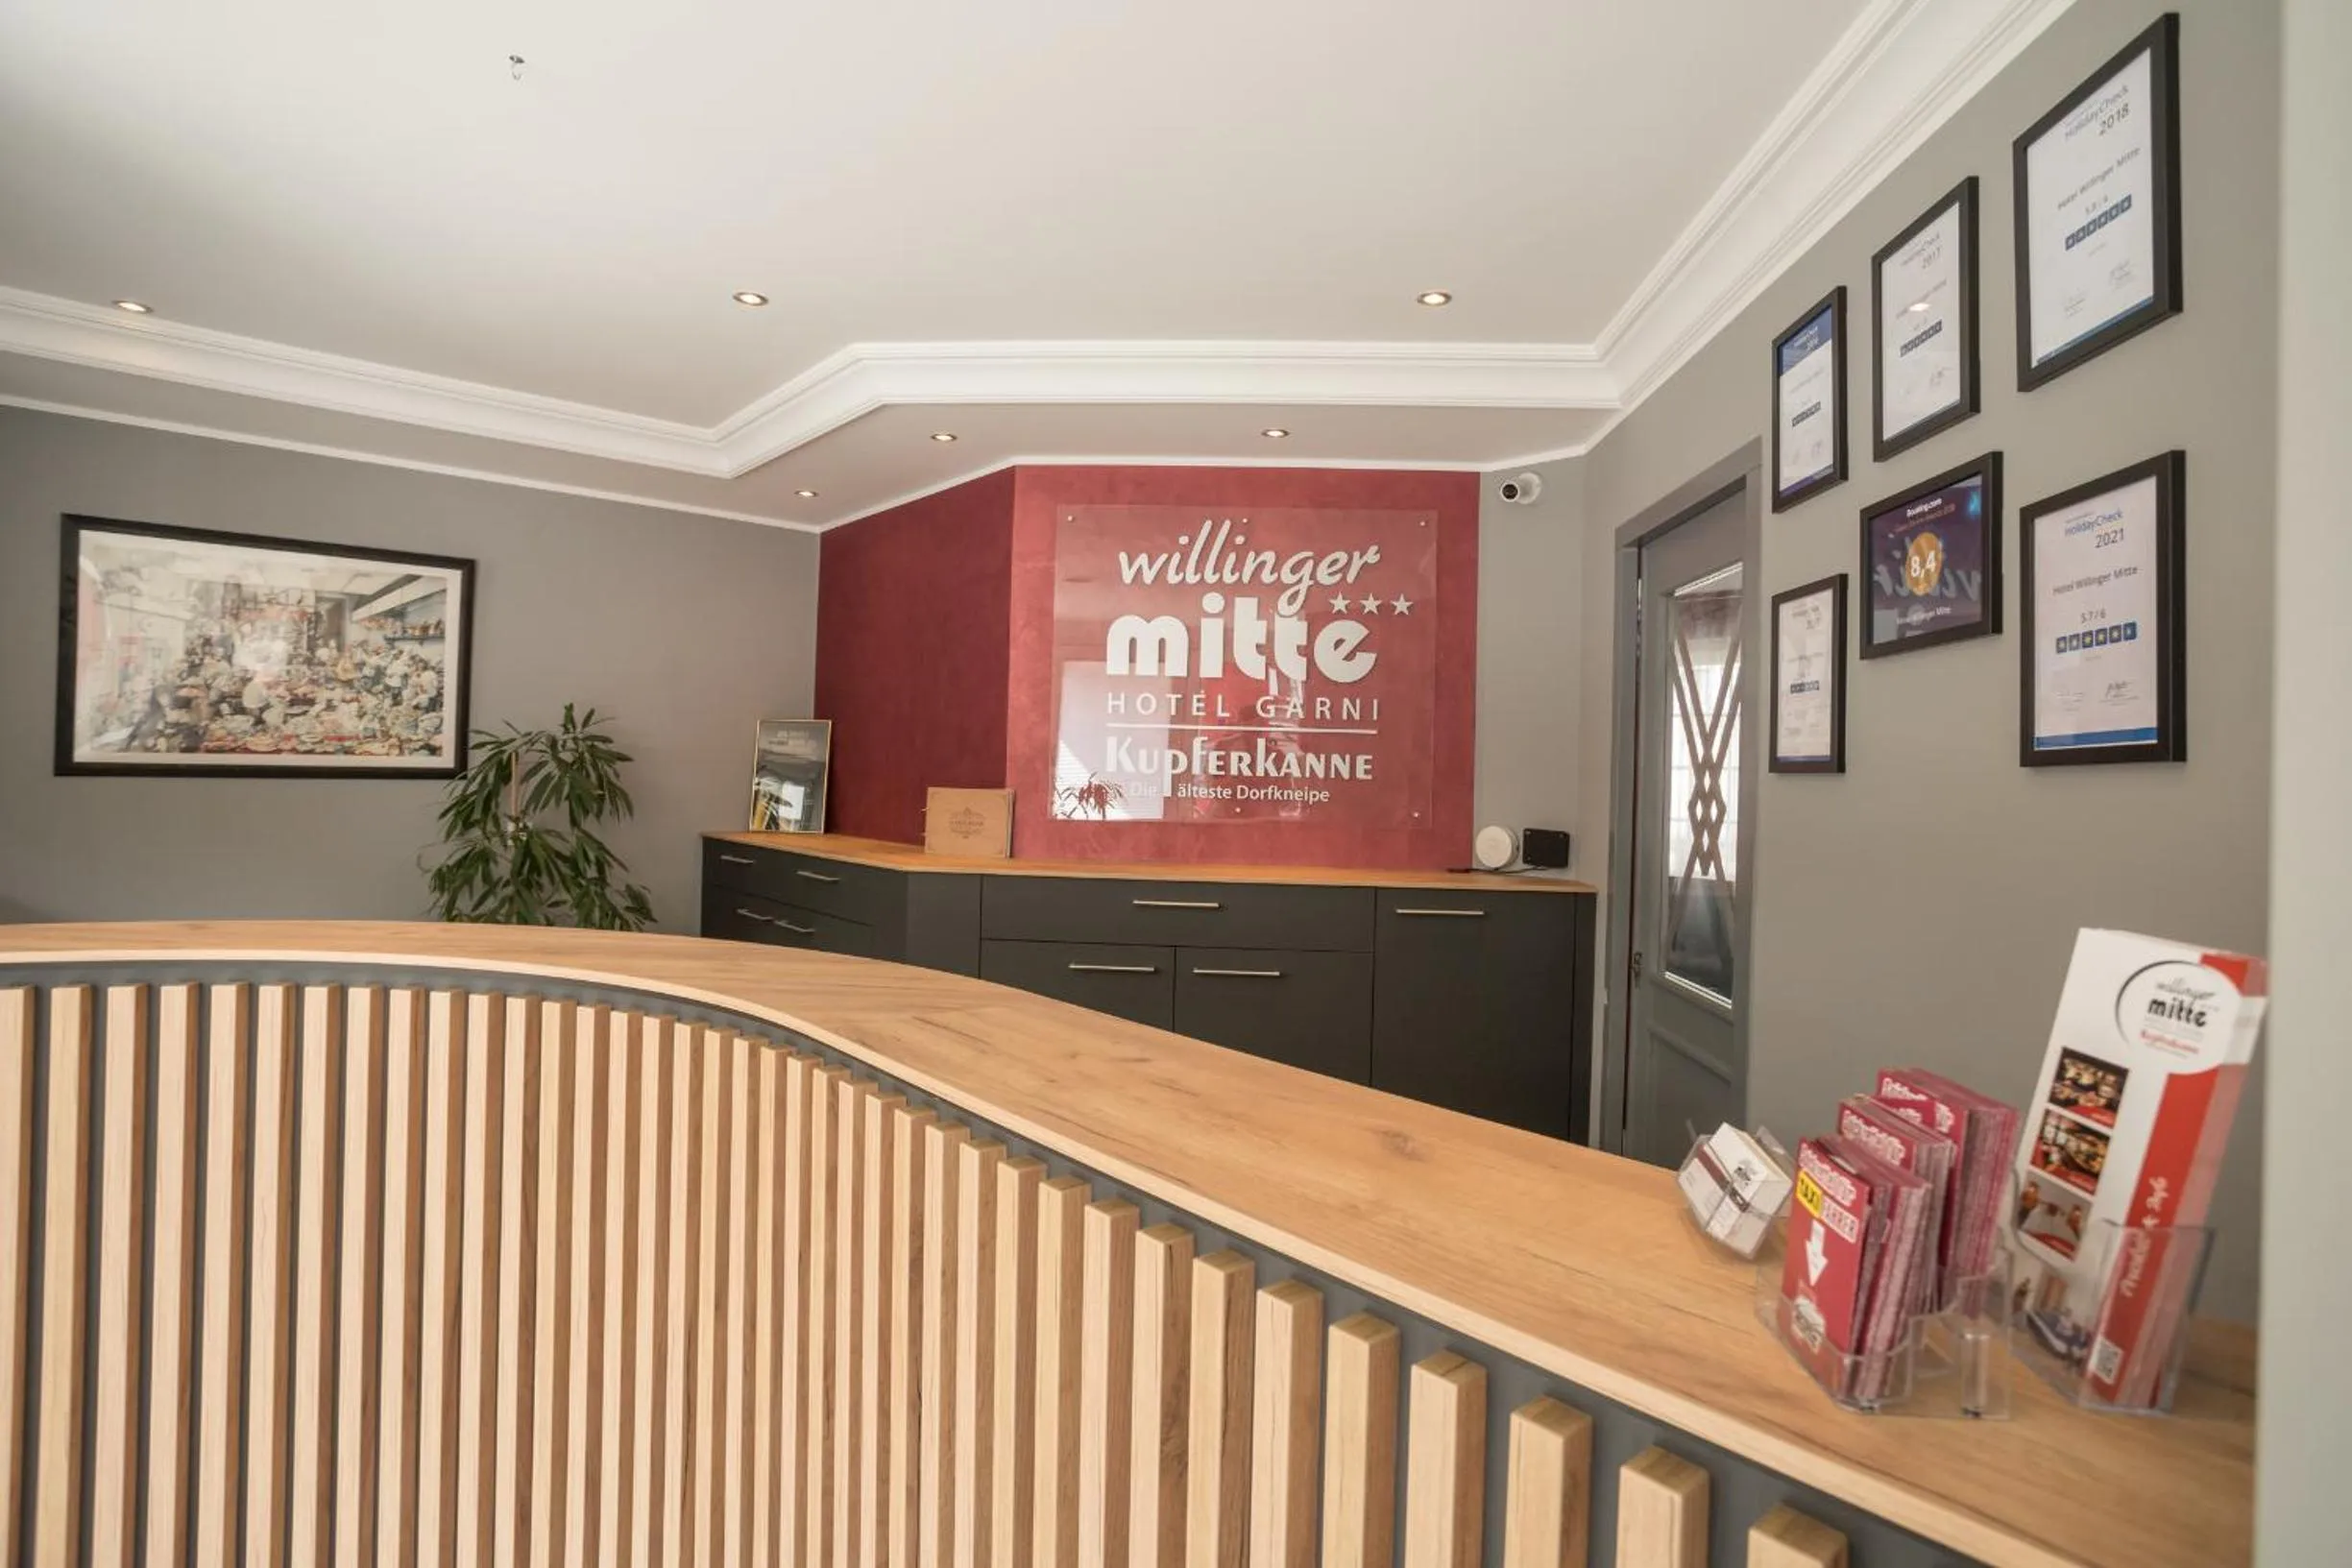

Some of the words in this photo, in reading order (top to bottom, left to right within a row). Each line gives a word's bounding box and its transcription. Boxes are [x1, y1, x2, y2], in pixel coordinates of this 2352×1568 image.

[2097, 102, 2131, 136] 2018
[2094, 527, 2125, 549] 2021
[1119, 519, 1381, 616] willinger
[1910, 549, 1937, 578] 8,4
[1106, 591, 1378, 684] mitte
[1107, 691, 1231, 718] HOTEL
[1255, 695, 1379, 720] GARNI
[1177, 783, 1232, 800] älteste
[1236, 784, 1331, 804] Dorfkneipe
[2146, 998, 2208, 1027] mitte
